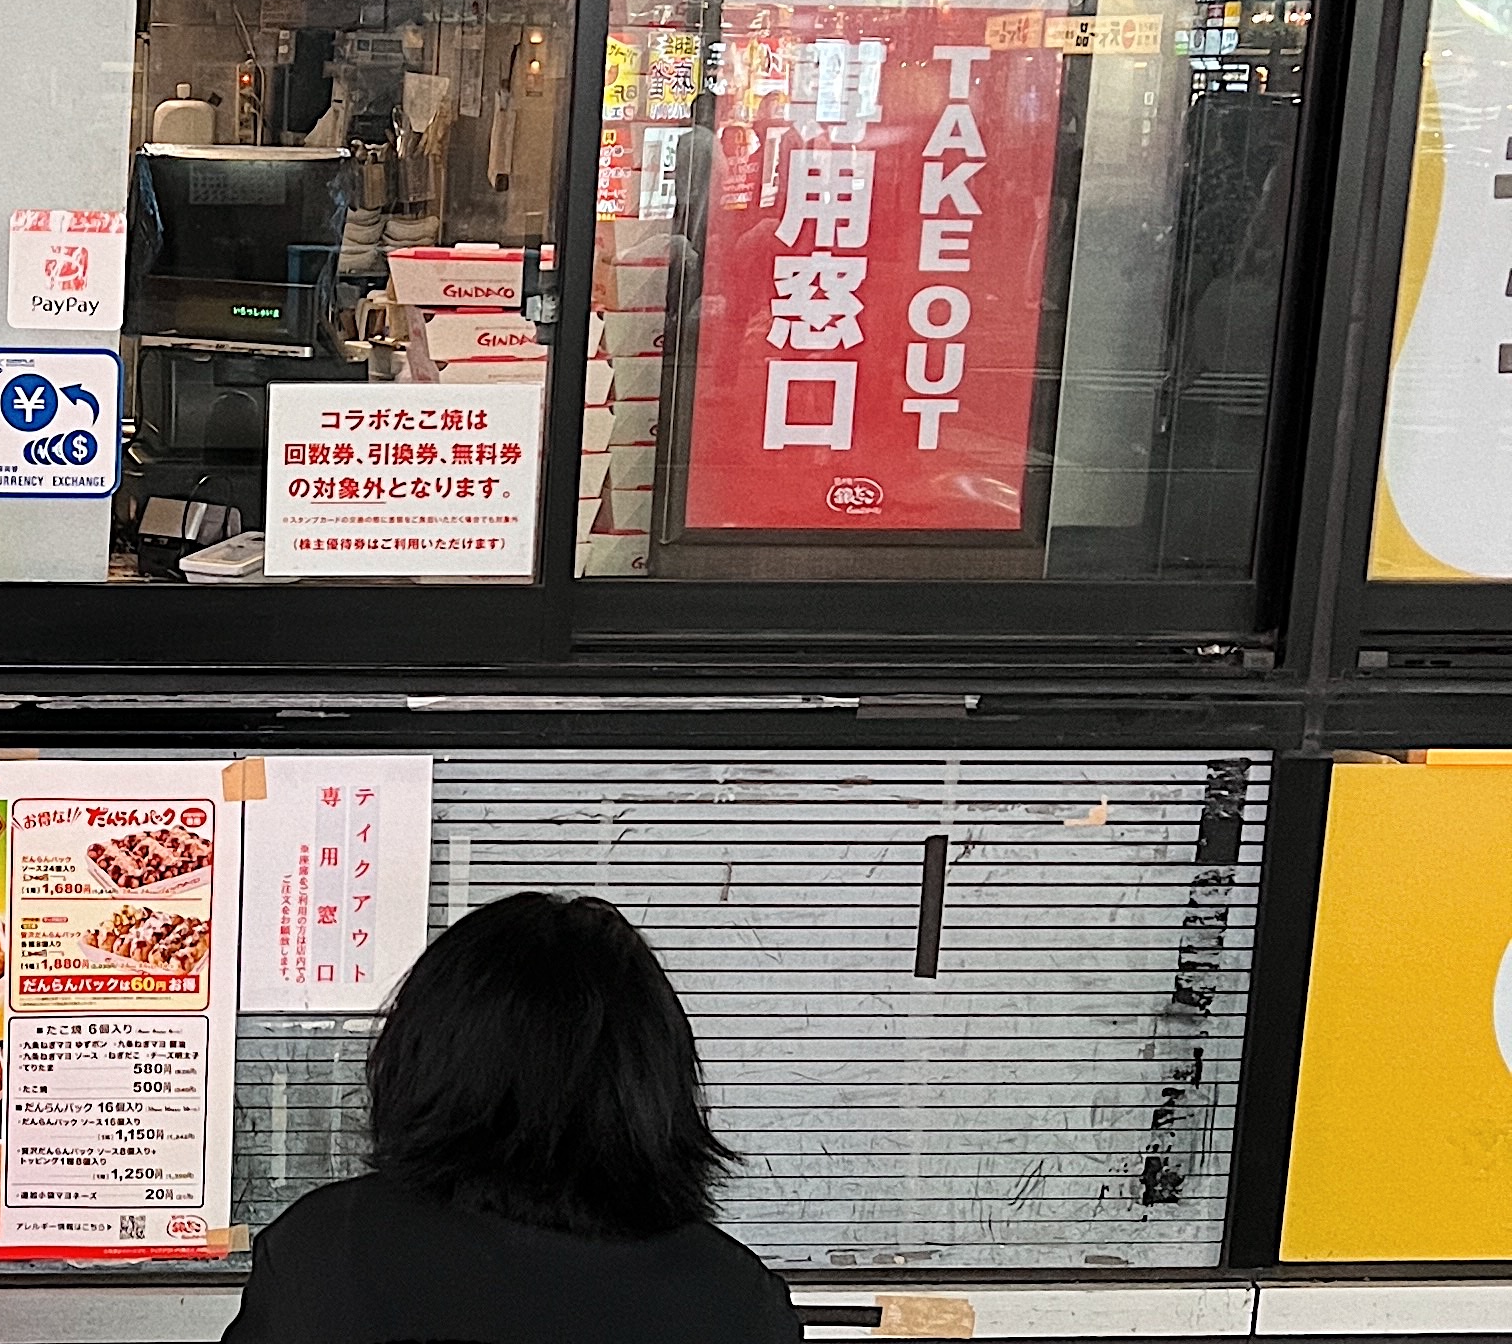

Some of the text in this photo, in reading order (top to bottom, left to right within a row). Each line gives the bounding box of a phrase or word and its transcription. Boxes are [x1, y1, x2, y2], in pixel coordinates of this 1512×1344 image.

[762, 39, 886, 452] 専用窓口
[902, 45, 991, 451] TAKE OUT
[442, 284, 516, 300] GINDACO
[31, 294, 100, 317] PayPay
[320, 408, 489, 432] コラボたこ焼は
[283, 443, 523, 466] 回数券、引換券、無料券
[52, 475, 106, 488] EXCHANGE
[288, 477, 511, 501] の対象外となります。
[86, 807, 176, 828] だんらんパック
[317, 785, 342, 983] 専用窓口
[352, 787, 376, 984] テイクアウト
[24, 1102, 93, 1113] だんらんパック
